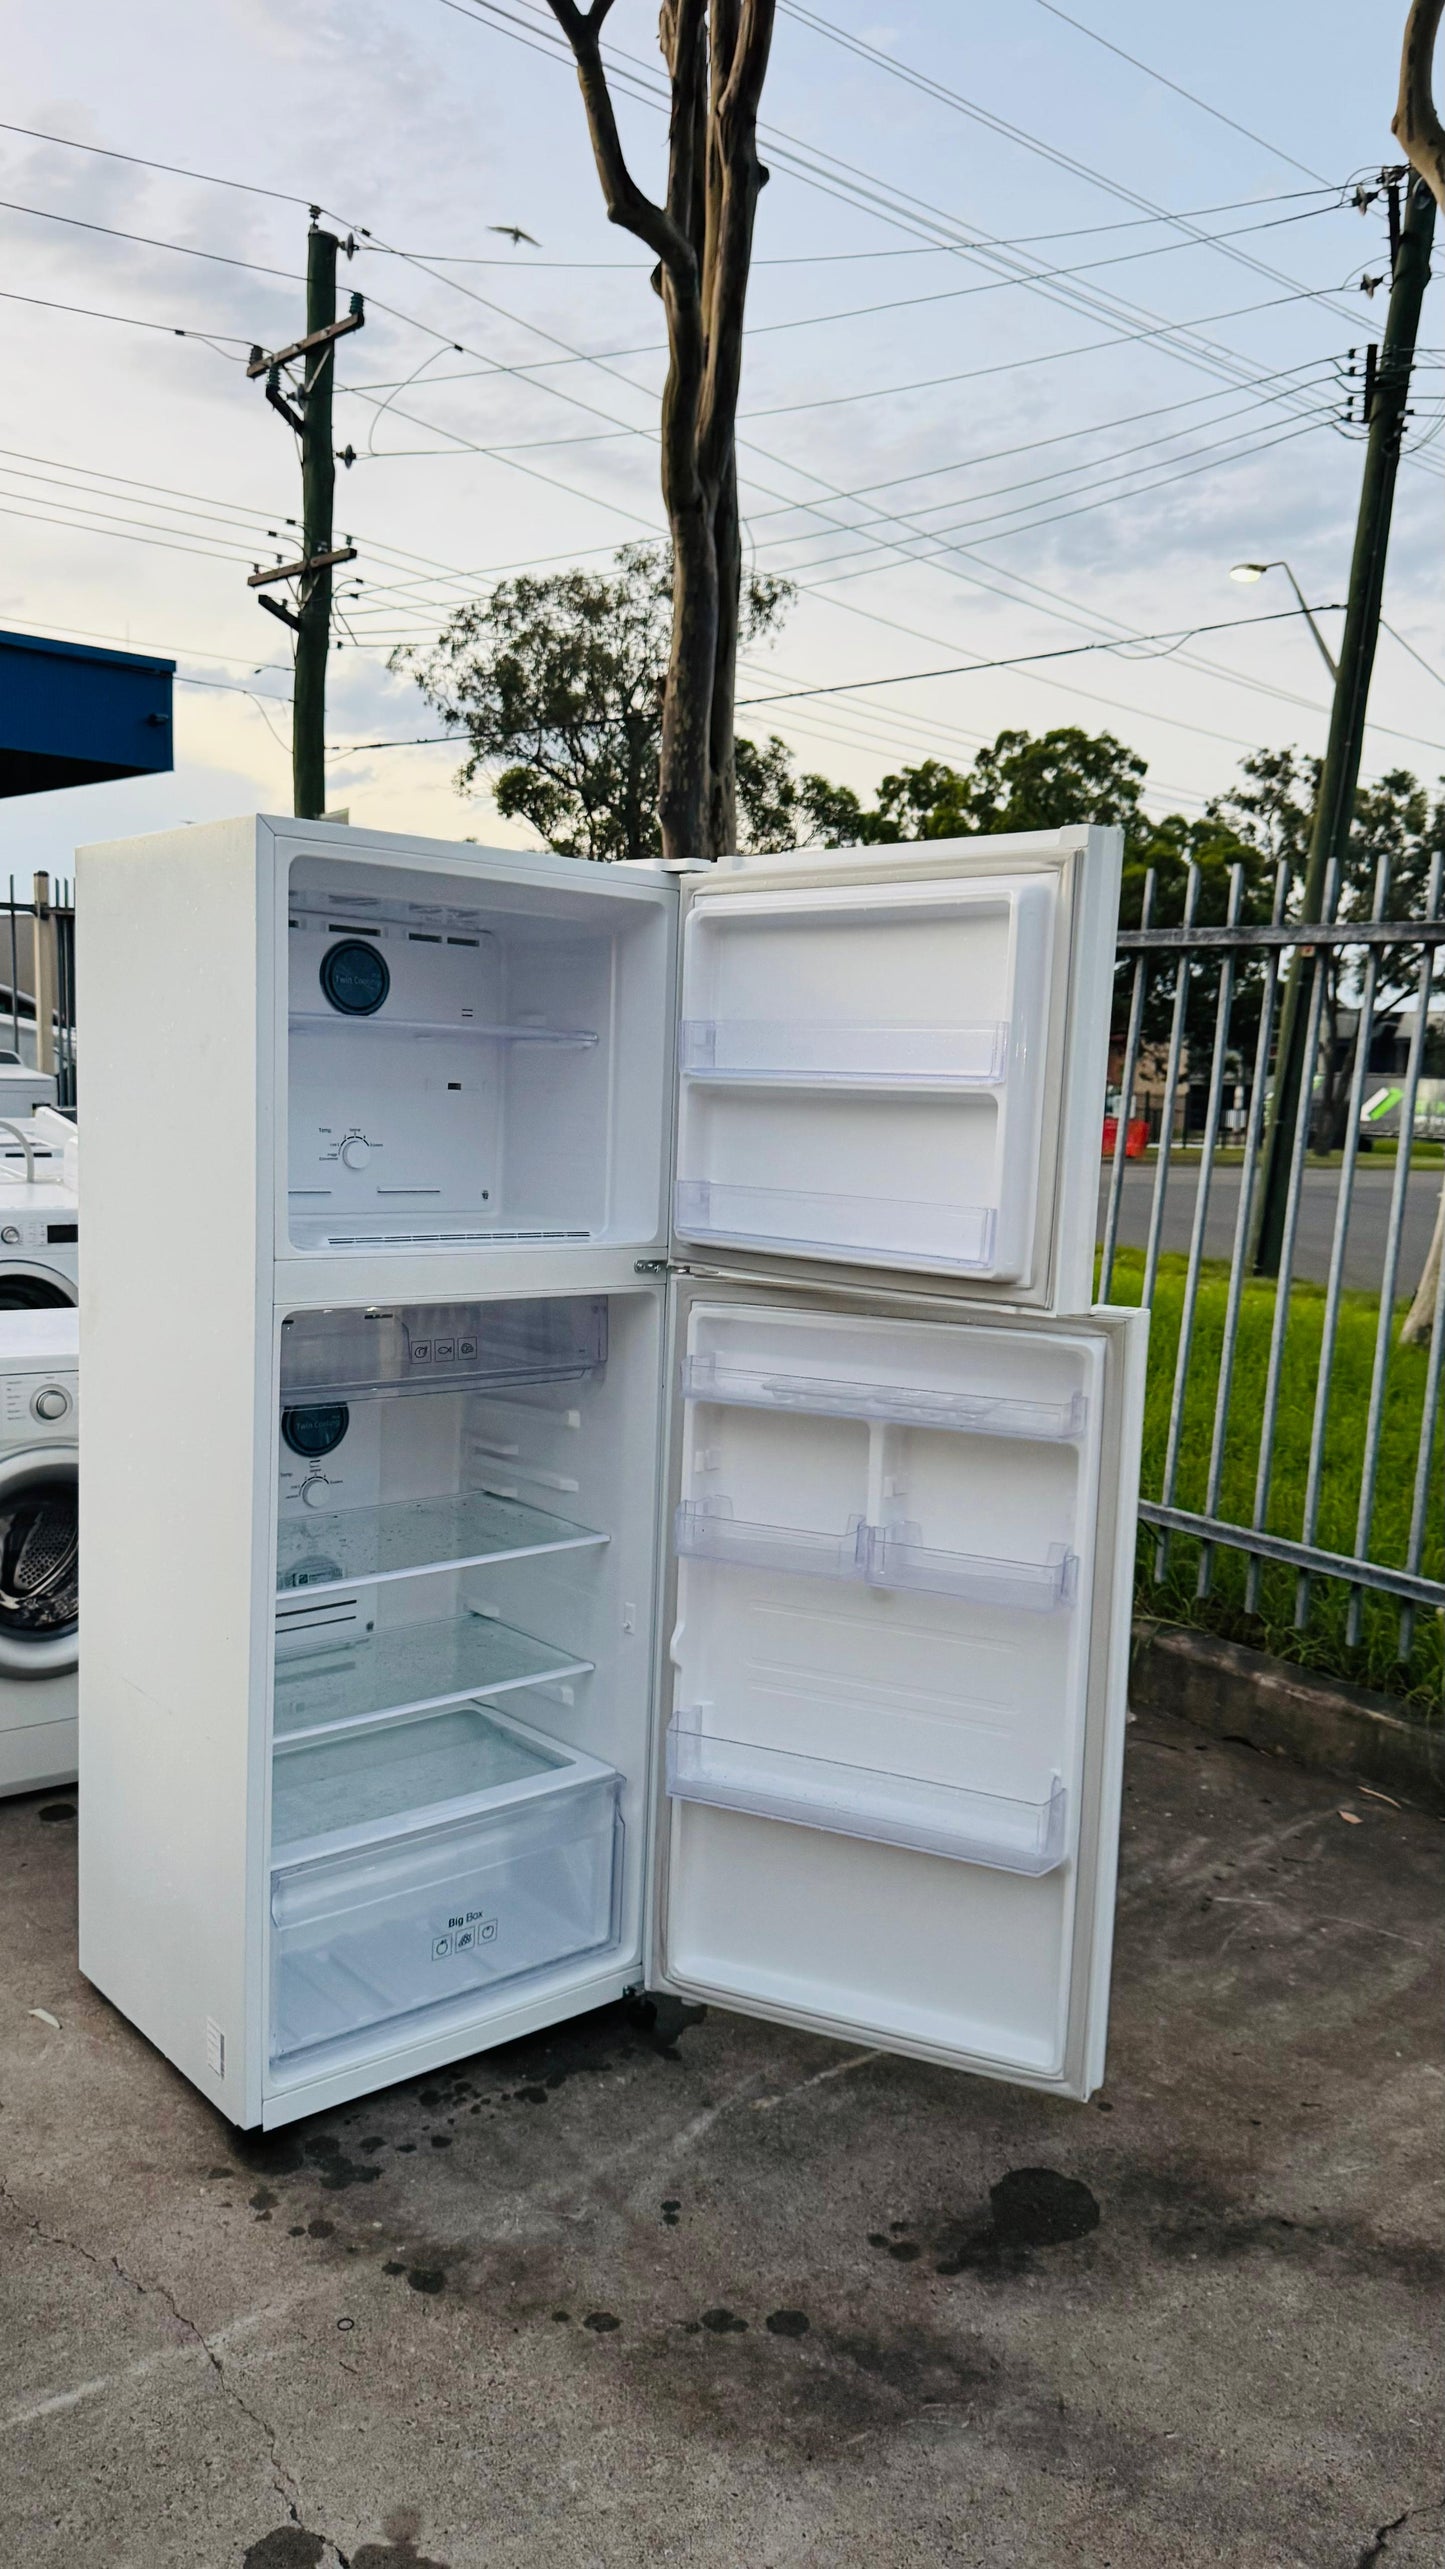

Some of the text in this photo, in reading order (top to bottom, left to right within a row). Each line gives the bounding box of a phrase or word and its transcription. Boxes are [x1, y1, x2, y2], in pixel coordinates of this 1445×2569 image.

[335, 975, 353, 985] Twin
[296, 1422, 312, 1431] Twin
[448, 1911, 483, 1928] Big Box
